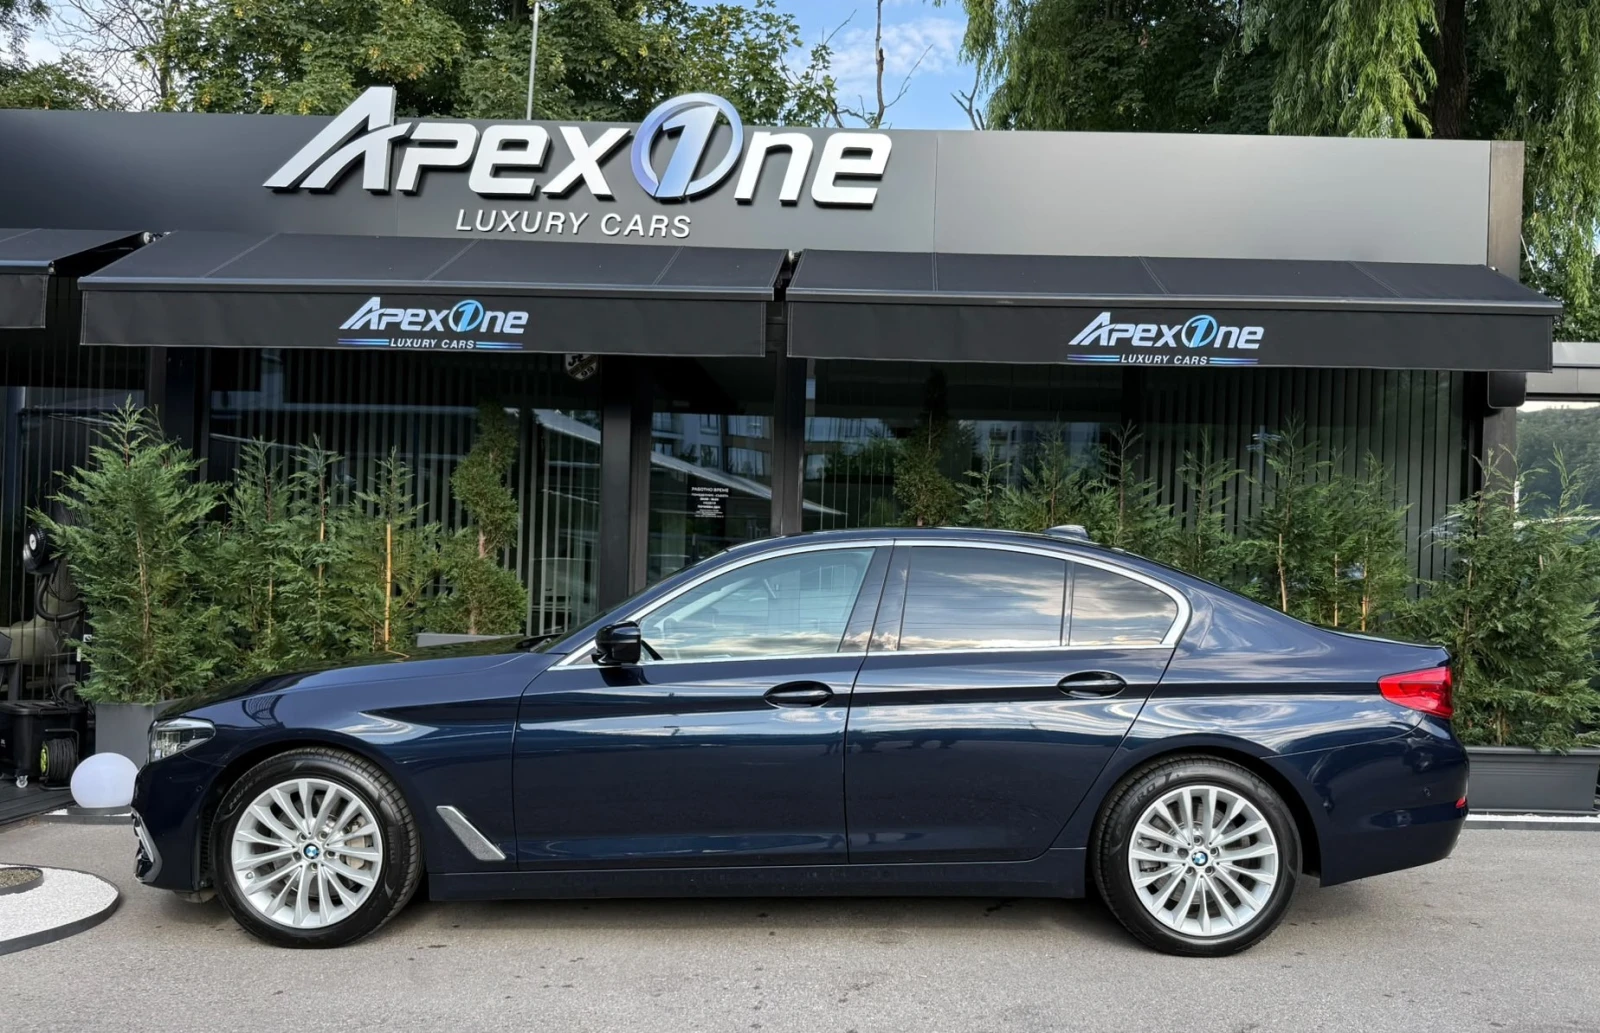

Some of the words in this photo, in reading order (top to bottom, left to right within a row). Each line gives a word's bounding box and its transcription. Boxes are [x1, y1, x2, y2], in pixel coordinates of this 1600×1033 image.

[455, 208, 588, 235] LUXURY
[600, 213, 692, 239] CARS
[390, 338, 438, 348] LUXURY
[441, 339, 476, 349] CARS
[1120, 354, 1170, 364] LUXURY
[1174, 355, 1209, 365] CARS
